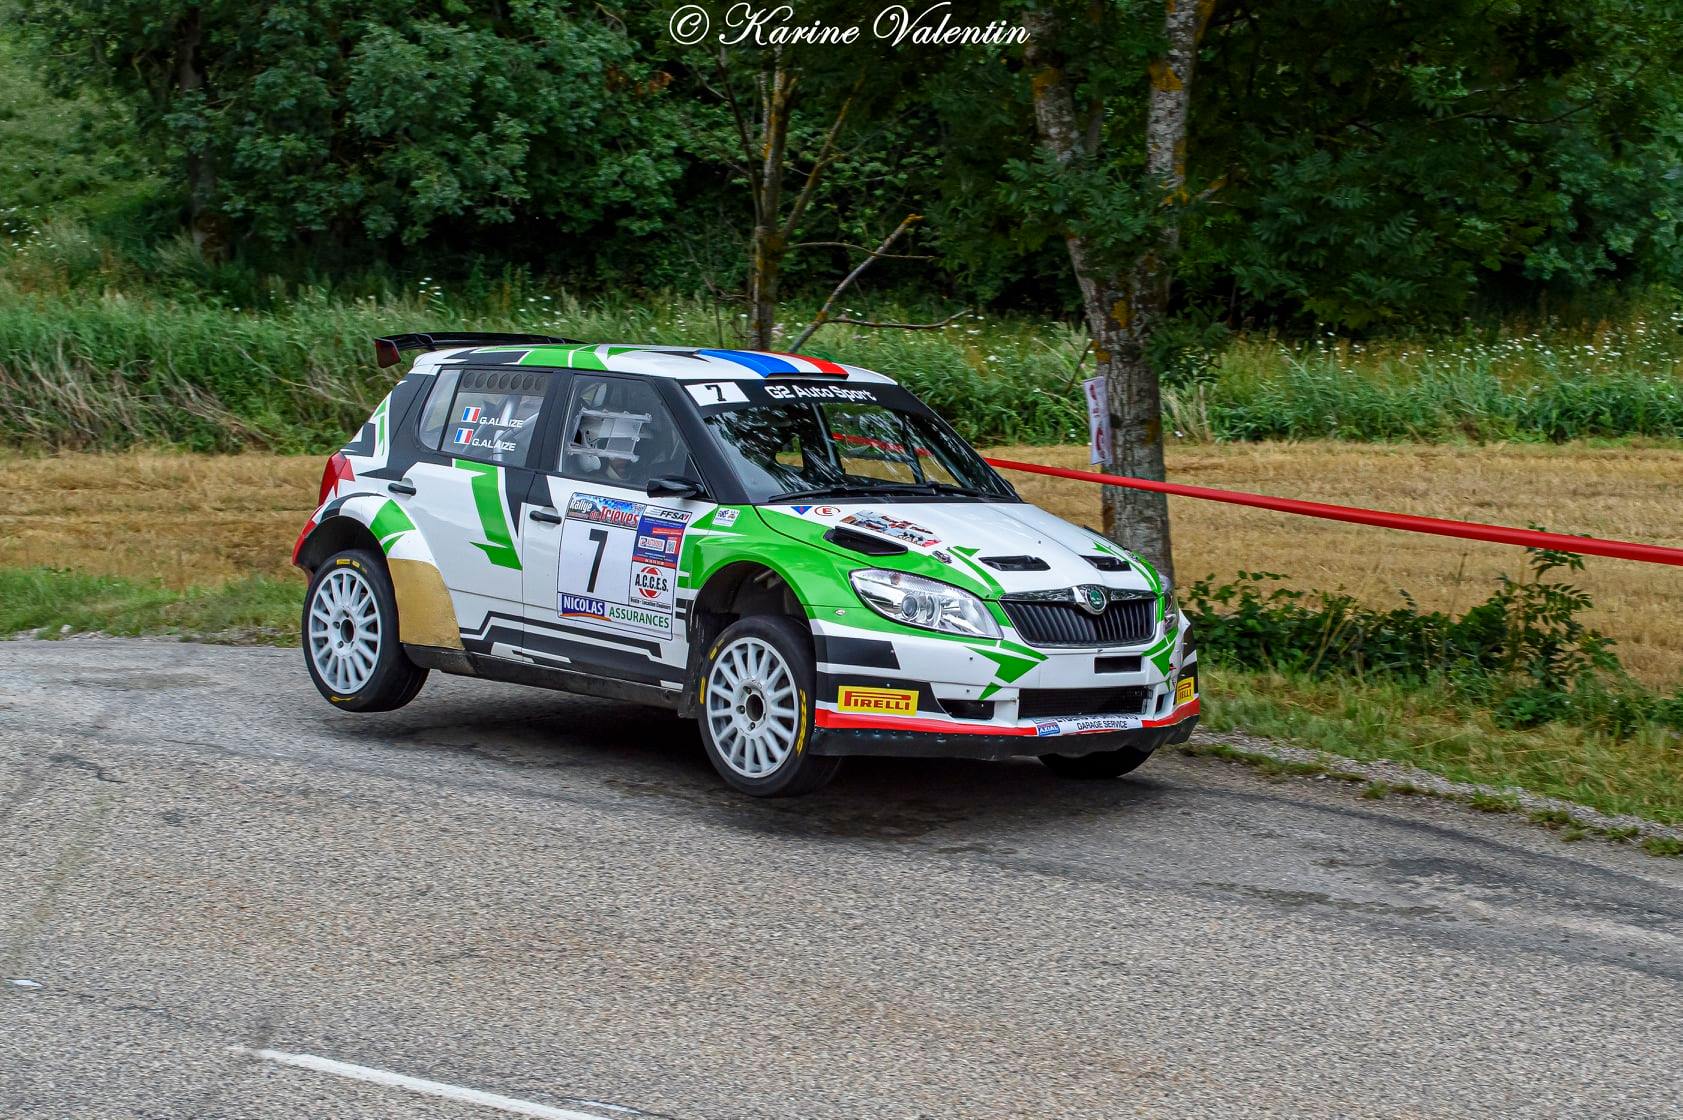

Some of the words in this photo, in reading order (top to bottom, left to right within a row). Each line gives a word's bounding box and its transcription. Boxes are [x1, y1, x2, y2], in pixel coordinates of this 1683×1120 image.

[706, 384, 727, 402] 7
[764, 386, 795, 399] G2
[479, 416, 524, 428] G.ALAIZE
[471, 438, 517, 451] G.ALAIZE
[660, 510, 686, 520] FFSA
[586, 528, 609, 594] 7
[635, 574, 669, 592] A.C.C.E.S.
[563, 595, 604, 615] NICOLAS
[608, 606, 670, 629] ASSURANCES
[844, 690, 912, 711] PIRELLI
[1077, 720, 1102, 730] GARAGE
[1102, 720, 1128, 729] SERVICE
